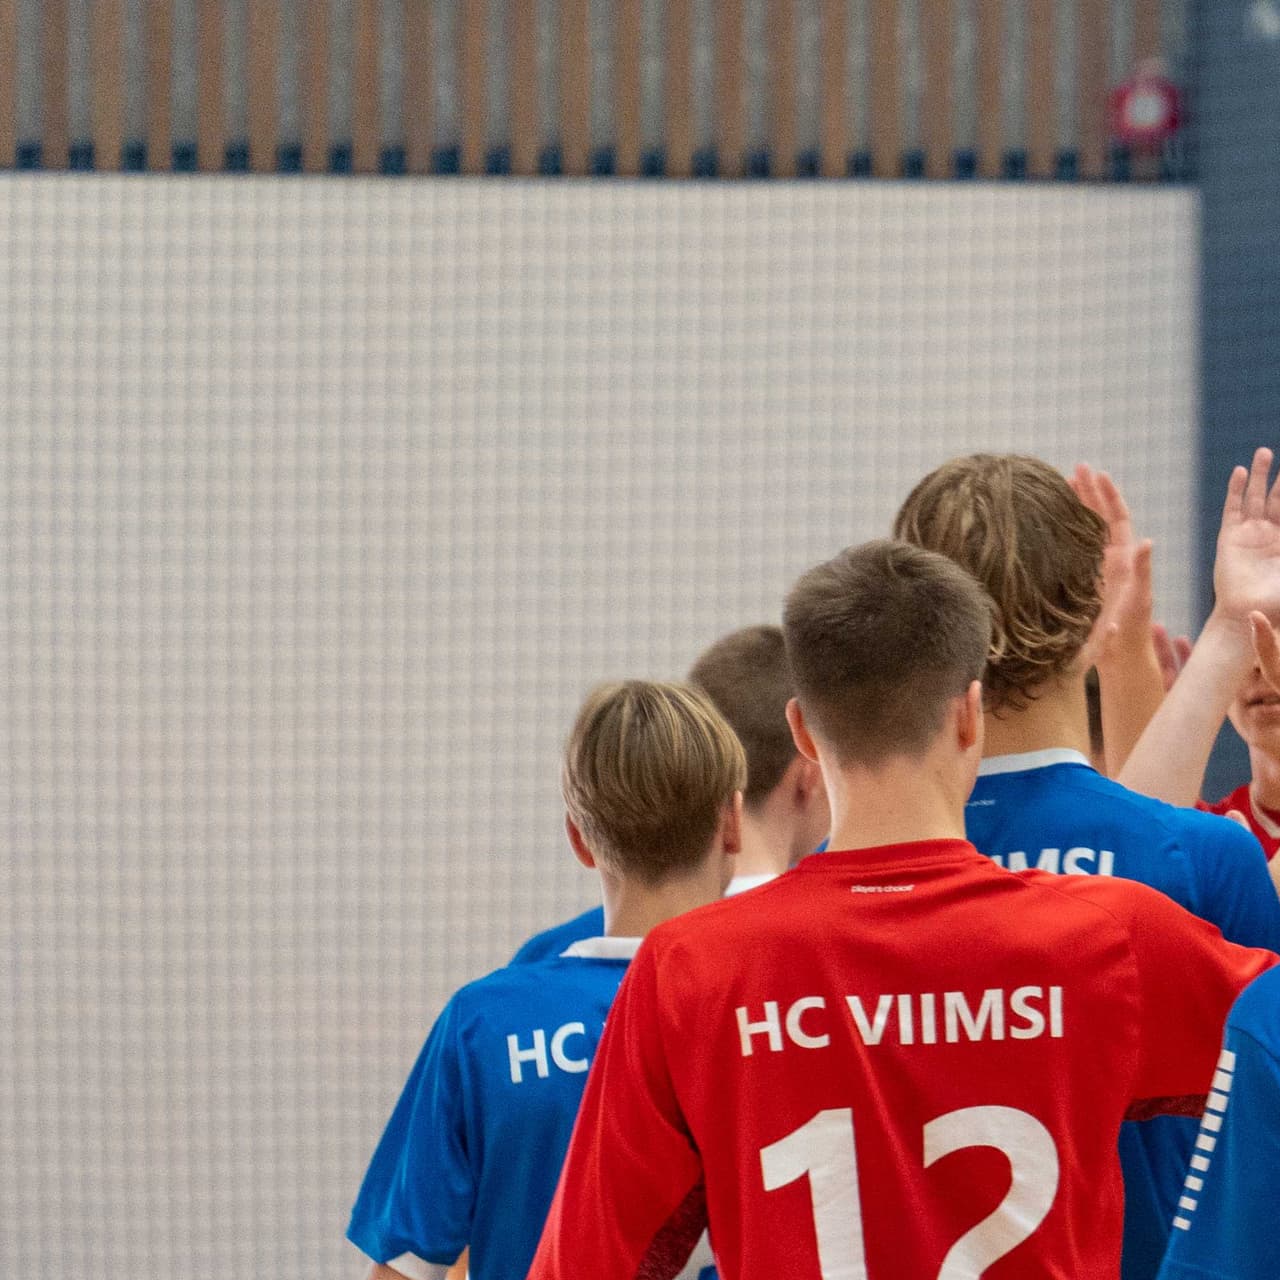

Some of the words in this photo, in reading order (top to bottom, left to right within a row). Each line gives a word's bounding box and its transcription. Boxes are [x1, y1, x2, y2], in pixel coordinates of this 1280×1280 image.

[506, 1021, 589, 1084] HC
[735, 997, 830, 1057] HC
[846, 986, 1064, 1046] VIIMSI
